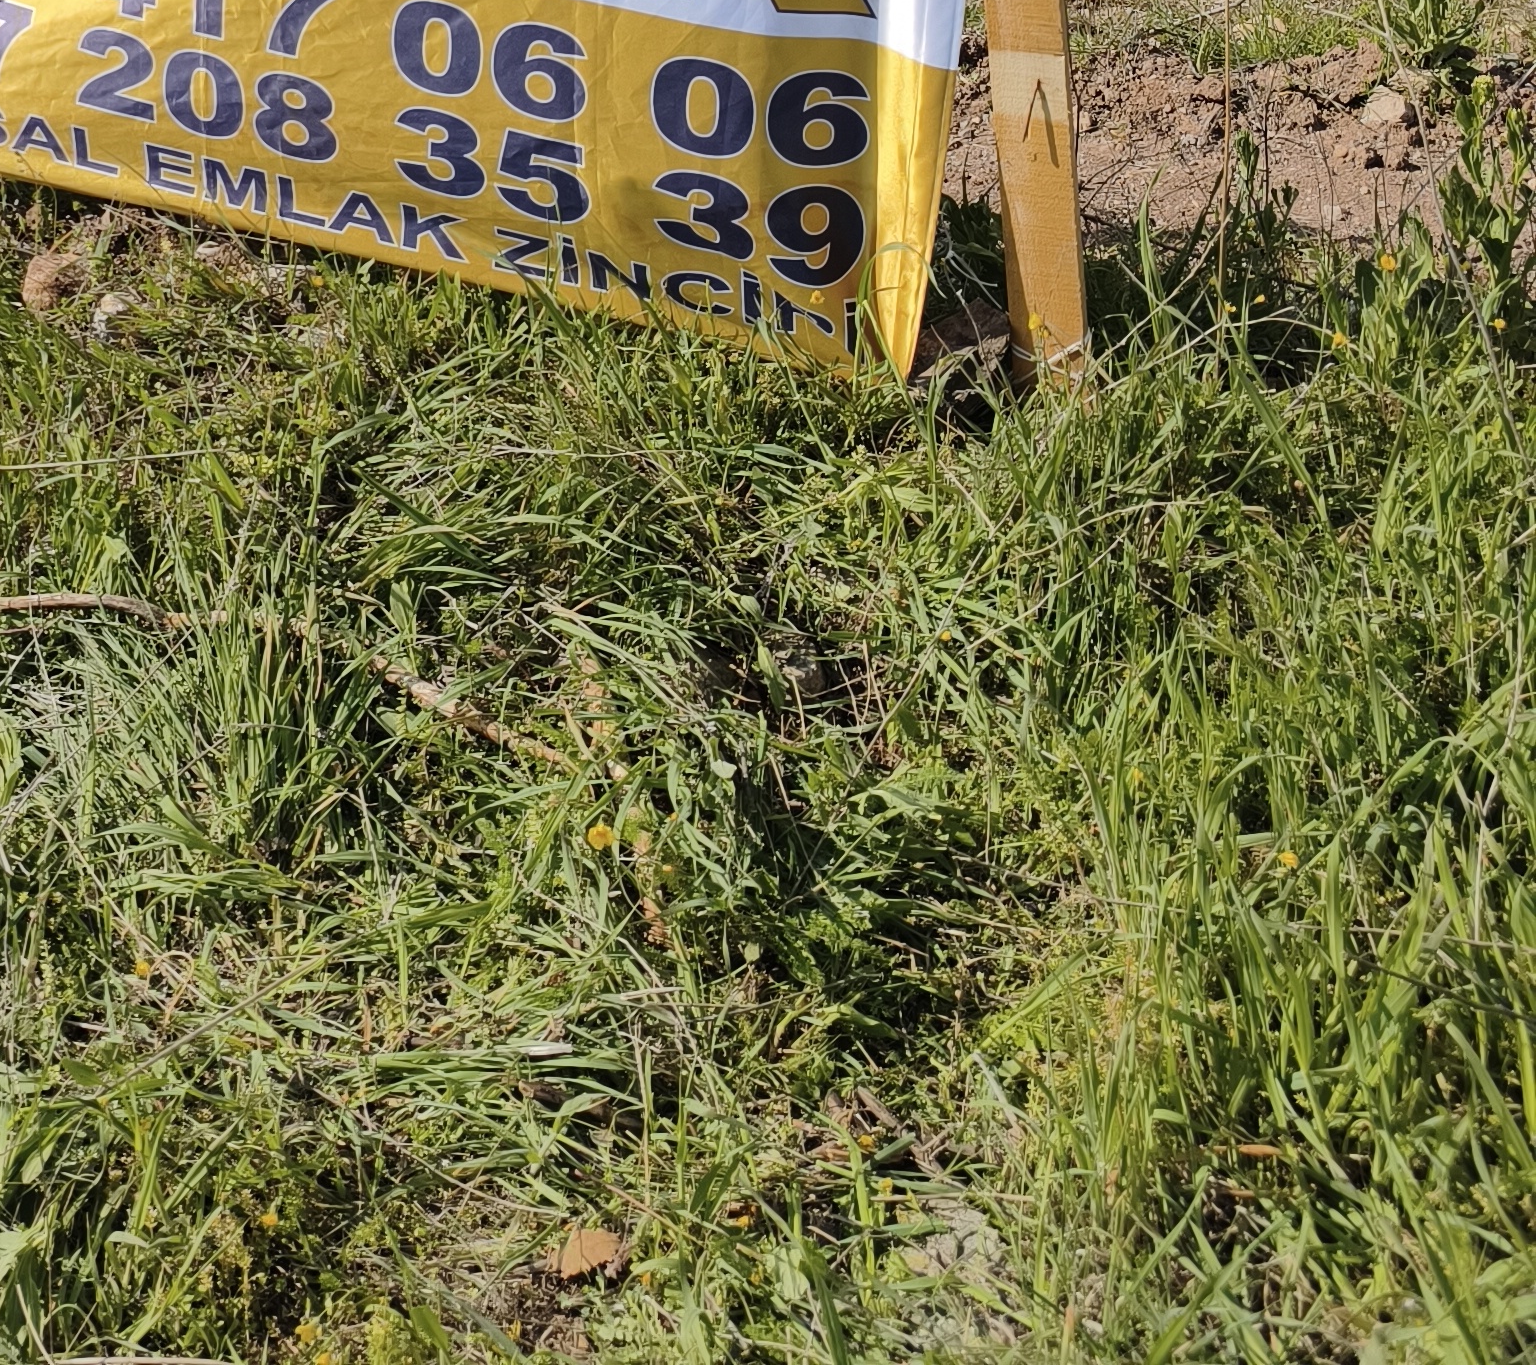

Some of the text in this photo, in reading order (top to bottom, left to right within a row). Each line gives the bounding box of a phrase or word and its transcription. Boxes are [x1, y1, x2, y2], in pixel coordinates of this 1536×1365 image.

[76, 26, 338, 163] 208
[394, 106, 591, 224] 35
[653, 170, 865, 287] 39
[650, 56, 870, 168] 06
[144, 142, 470, 263] EMLAK
